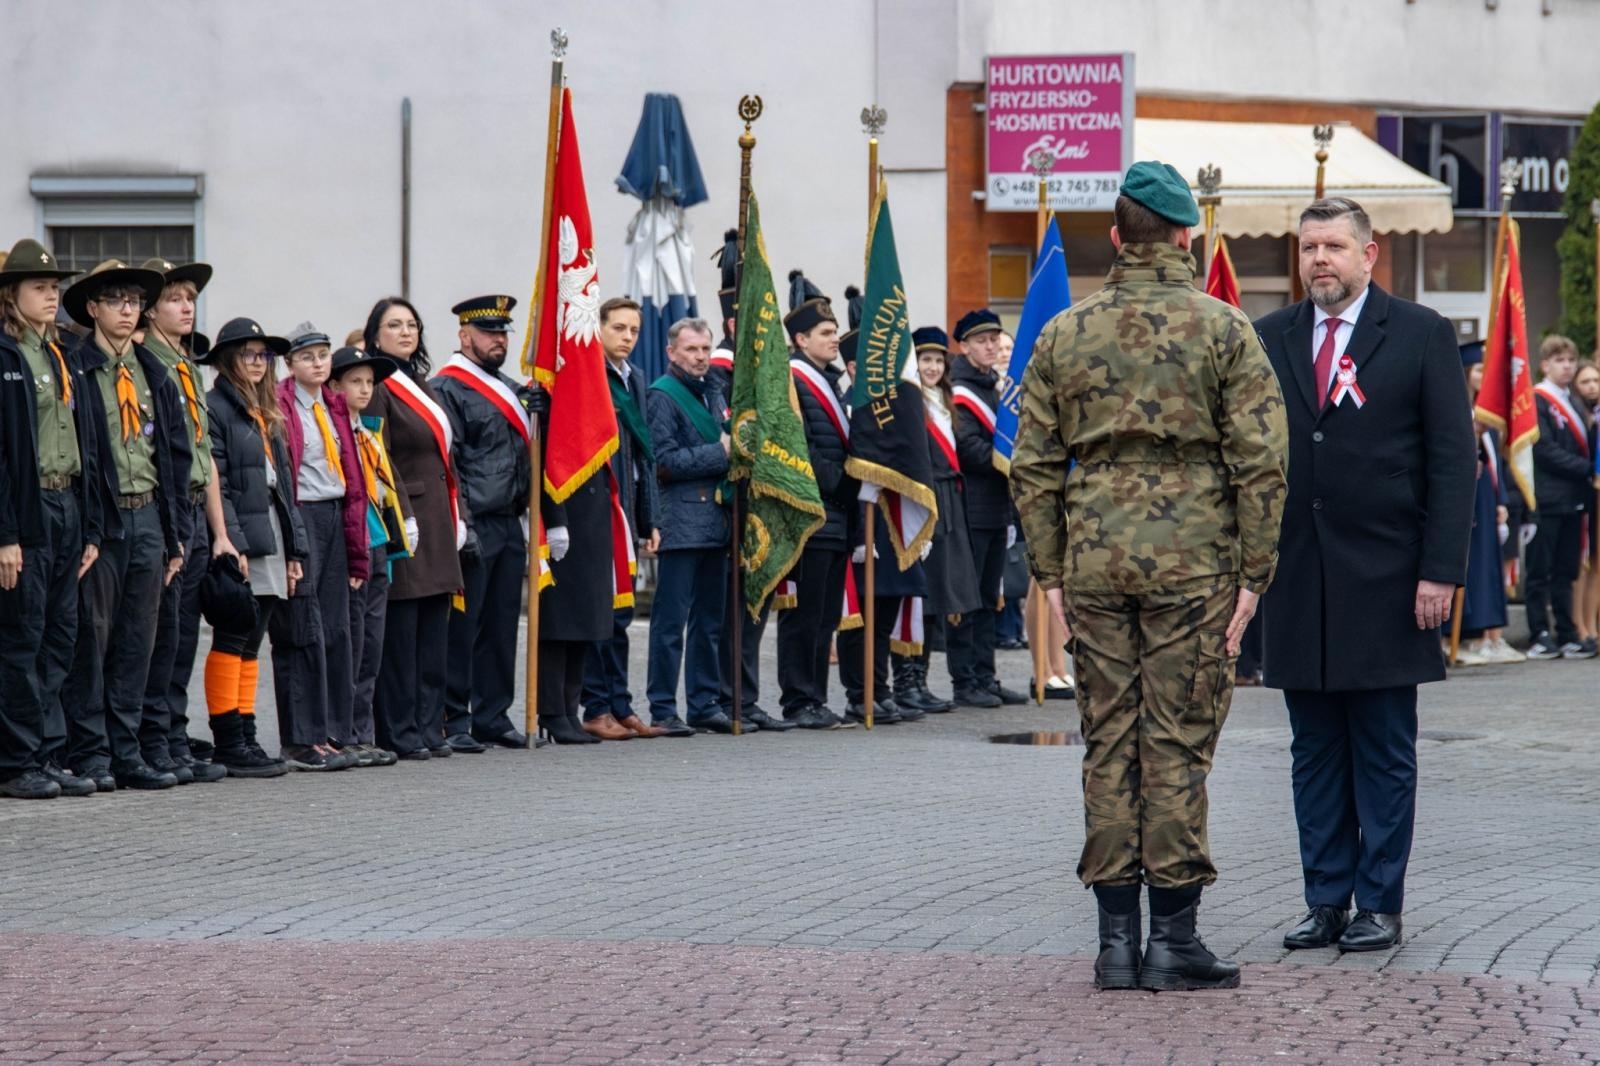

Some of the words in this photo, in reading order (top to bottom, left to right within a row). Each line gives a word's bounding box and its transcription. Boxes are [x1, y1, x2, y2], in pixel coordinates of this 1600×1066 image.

[990, 62, 1122, 86] HURTOWNIA
[990, 89, 1098, 109] FRYZJERSKO-
[990, 112, 1122, 132] -KOSMETYCZNA
[1040, 179, 1063, 193] 82
[1067, 179, 1090, 193] 745
[866, 284, 907, 430] TECHNIKUM
